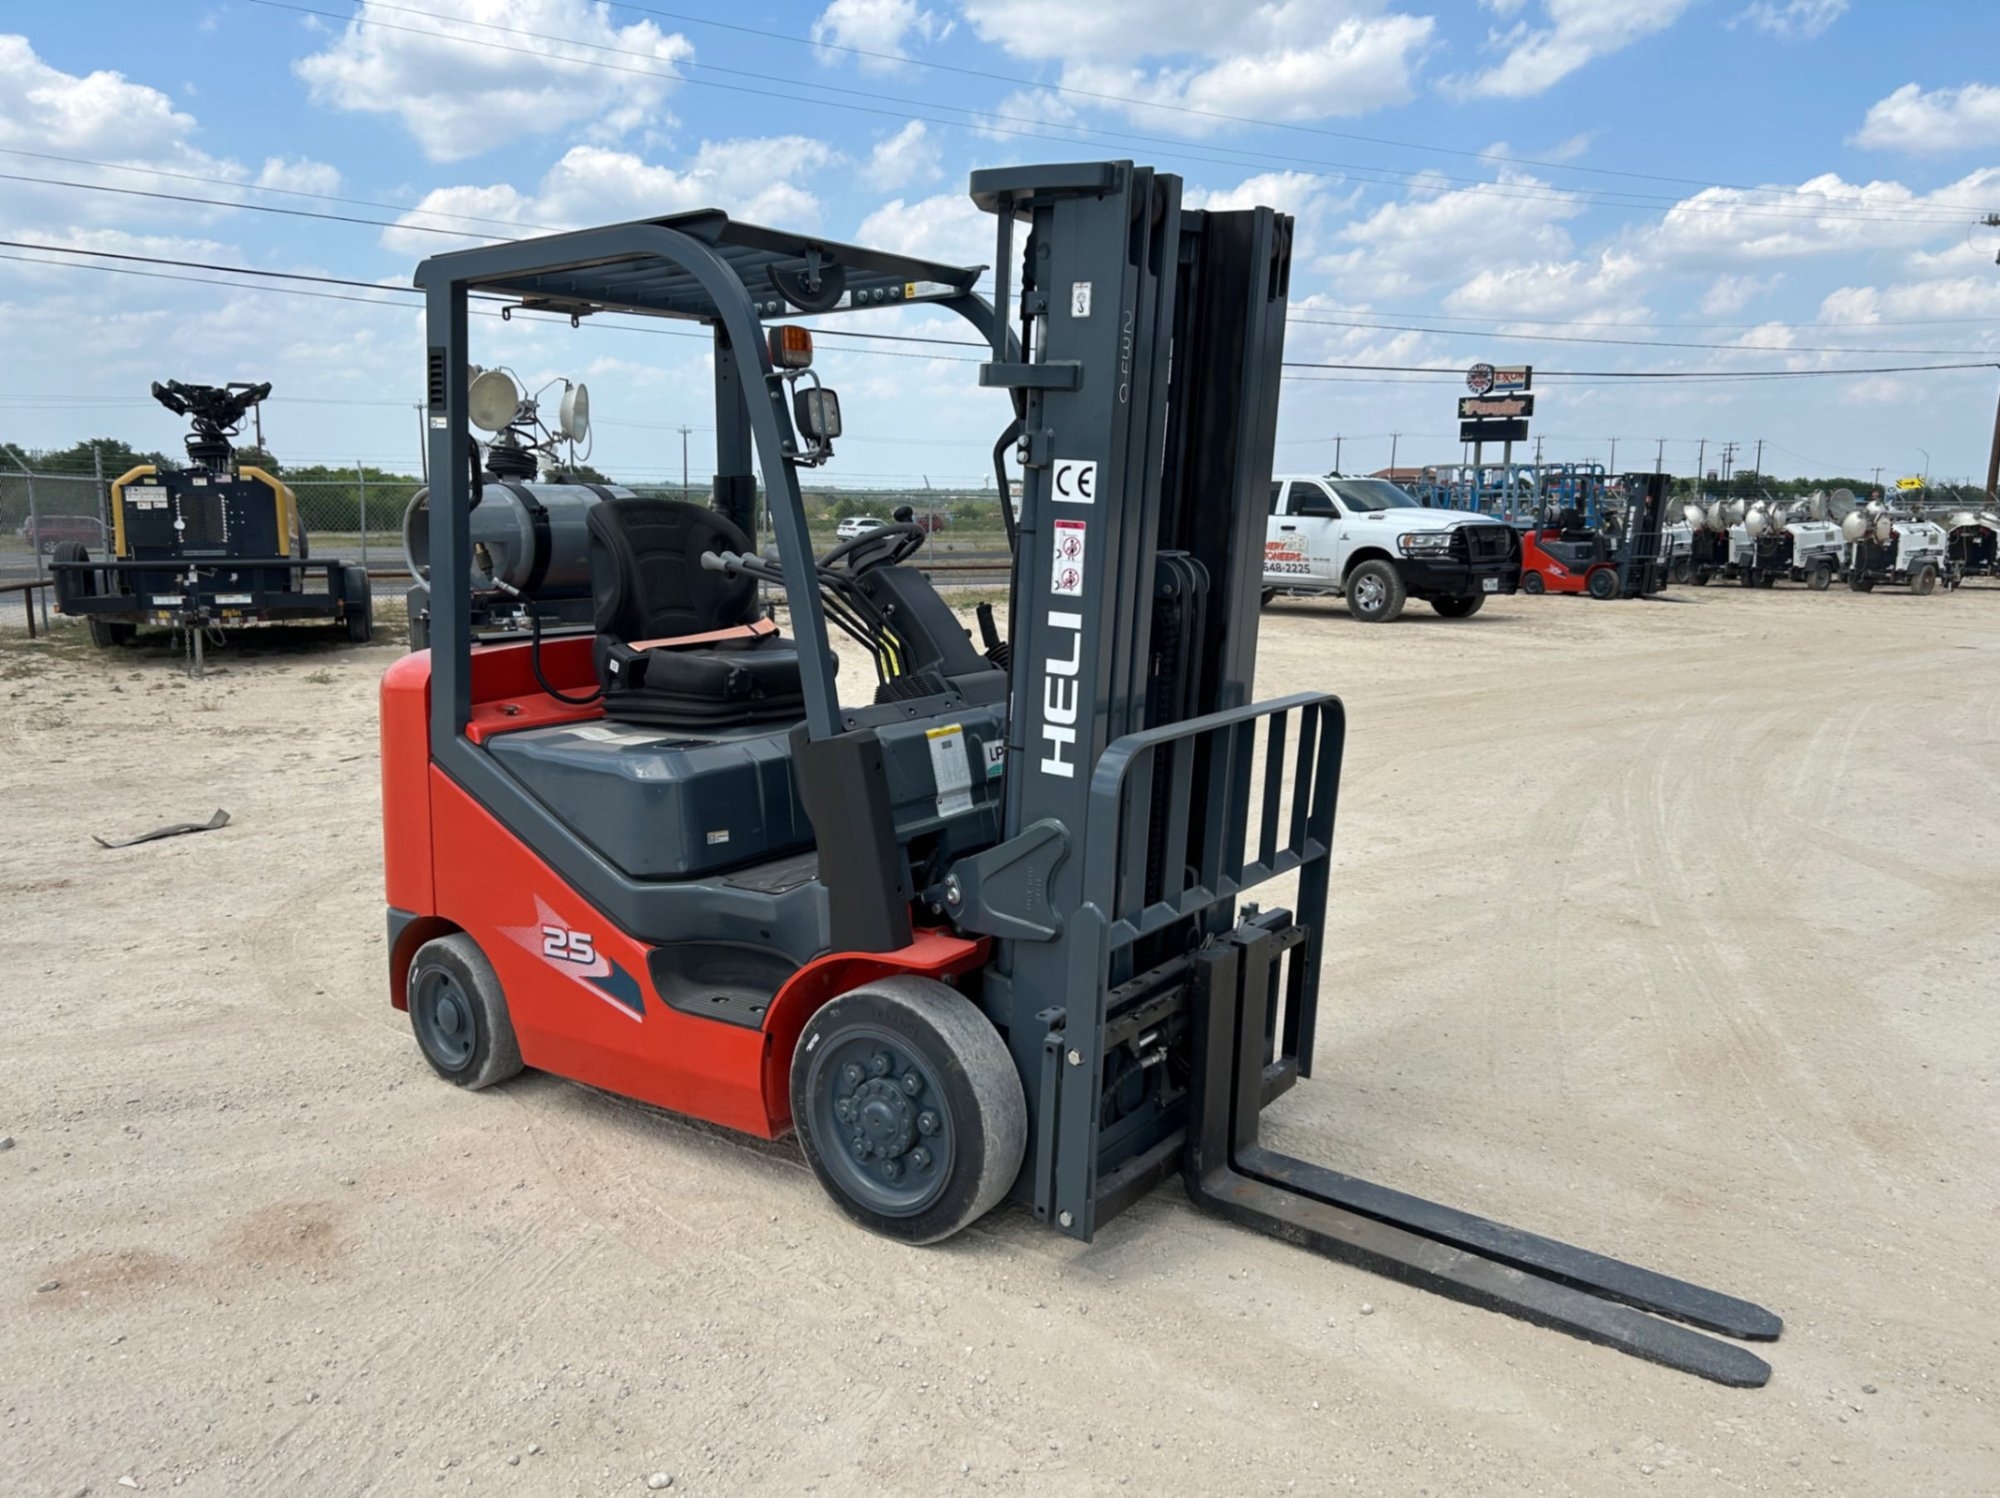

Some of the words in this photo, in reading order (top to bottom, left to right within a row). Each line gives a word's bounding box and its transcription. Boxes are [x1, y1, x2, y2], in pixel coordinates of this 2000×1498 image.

[1495, 371, 1524, 384] EXXON
[1056, 465, 1094, 498] CE
[1041, 610, 1083, 778] HELI
[989, 746, 1004, 761] LP
[542, 924, 596, 965] 25
